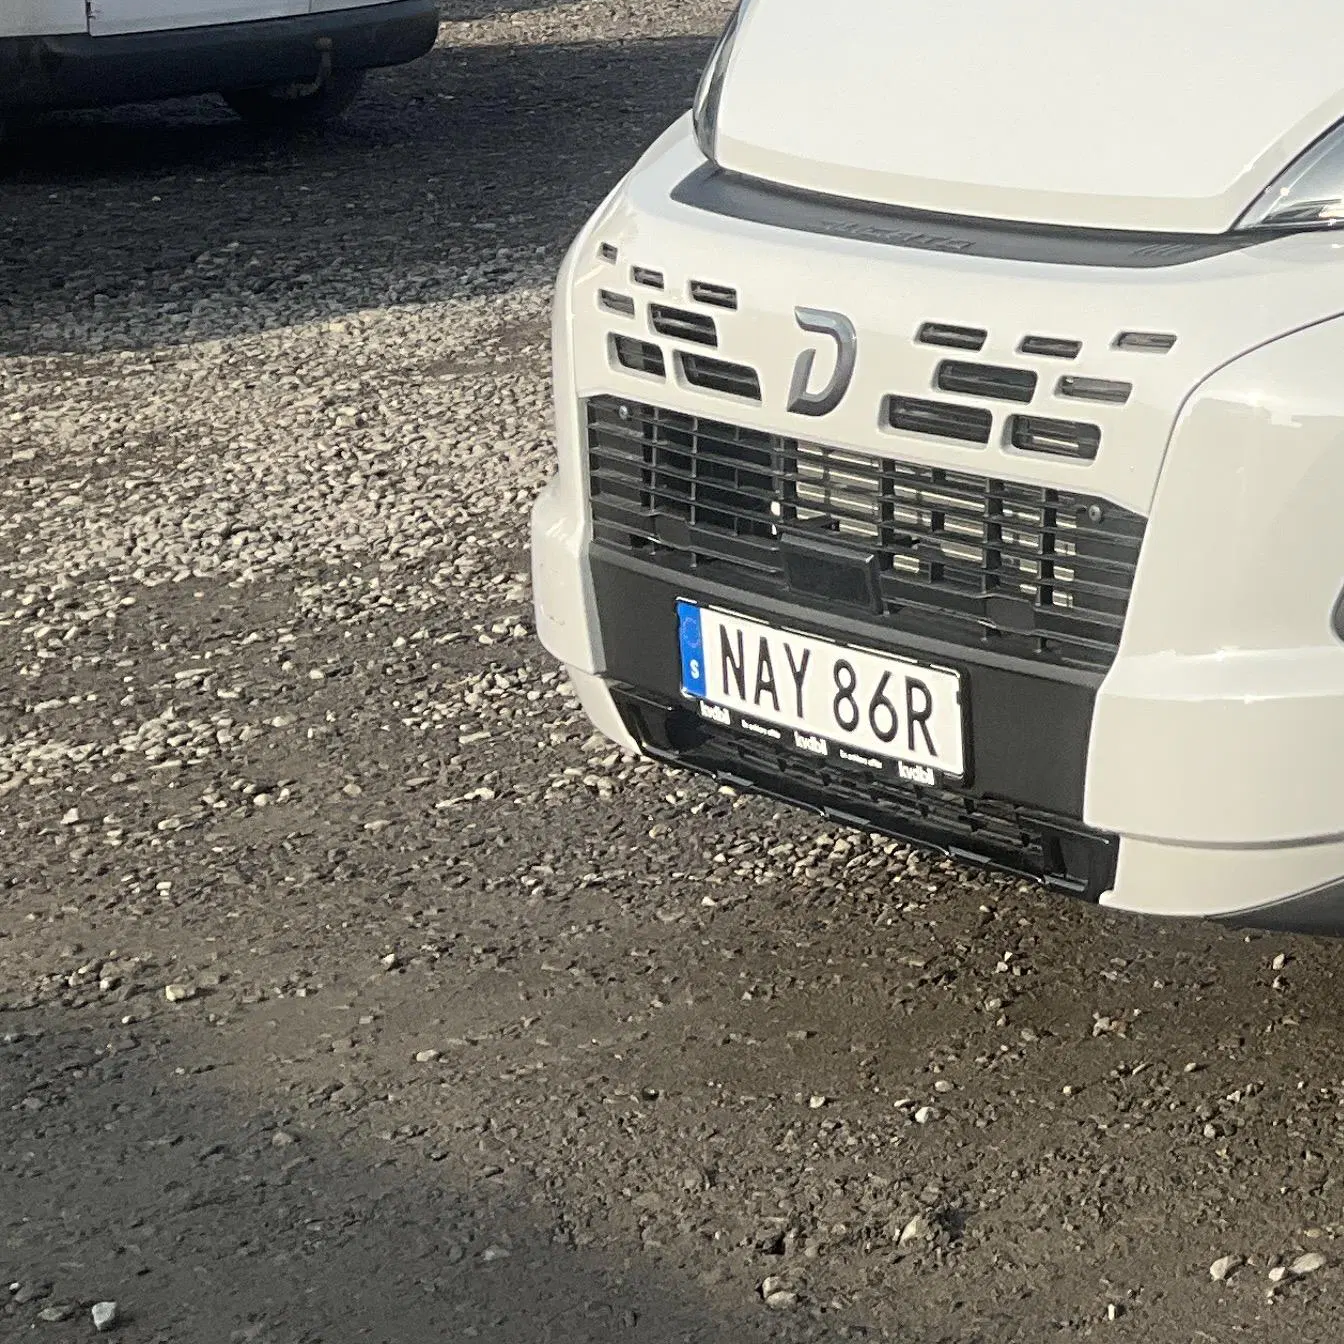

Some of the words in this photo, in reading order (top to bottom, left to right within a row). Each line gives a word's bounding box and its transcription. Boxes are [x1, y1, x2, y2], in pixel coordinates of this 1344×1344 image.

[689, 659, 700, 680] S
[719, 623, 810, 719] NAY
[833, 658, 937, 757] 86R
